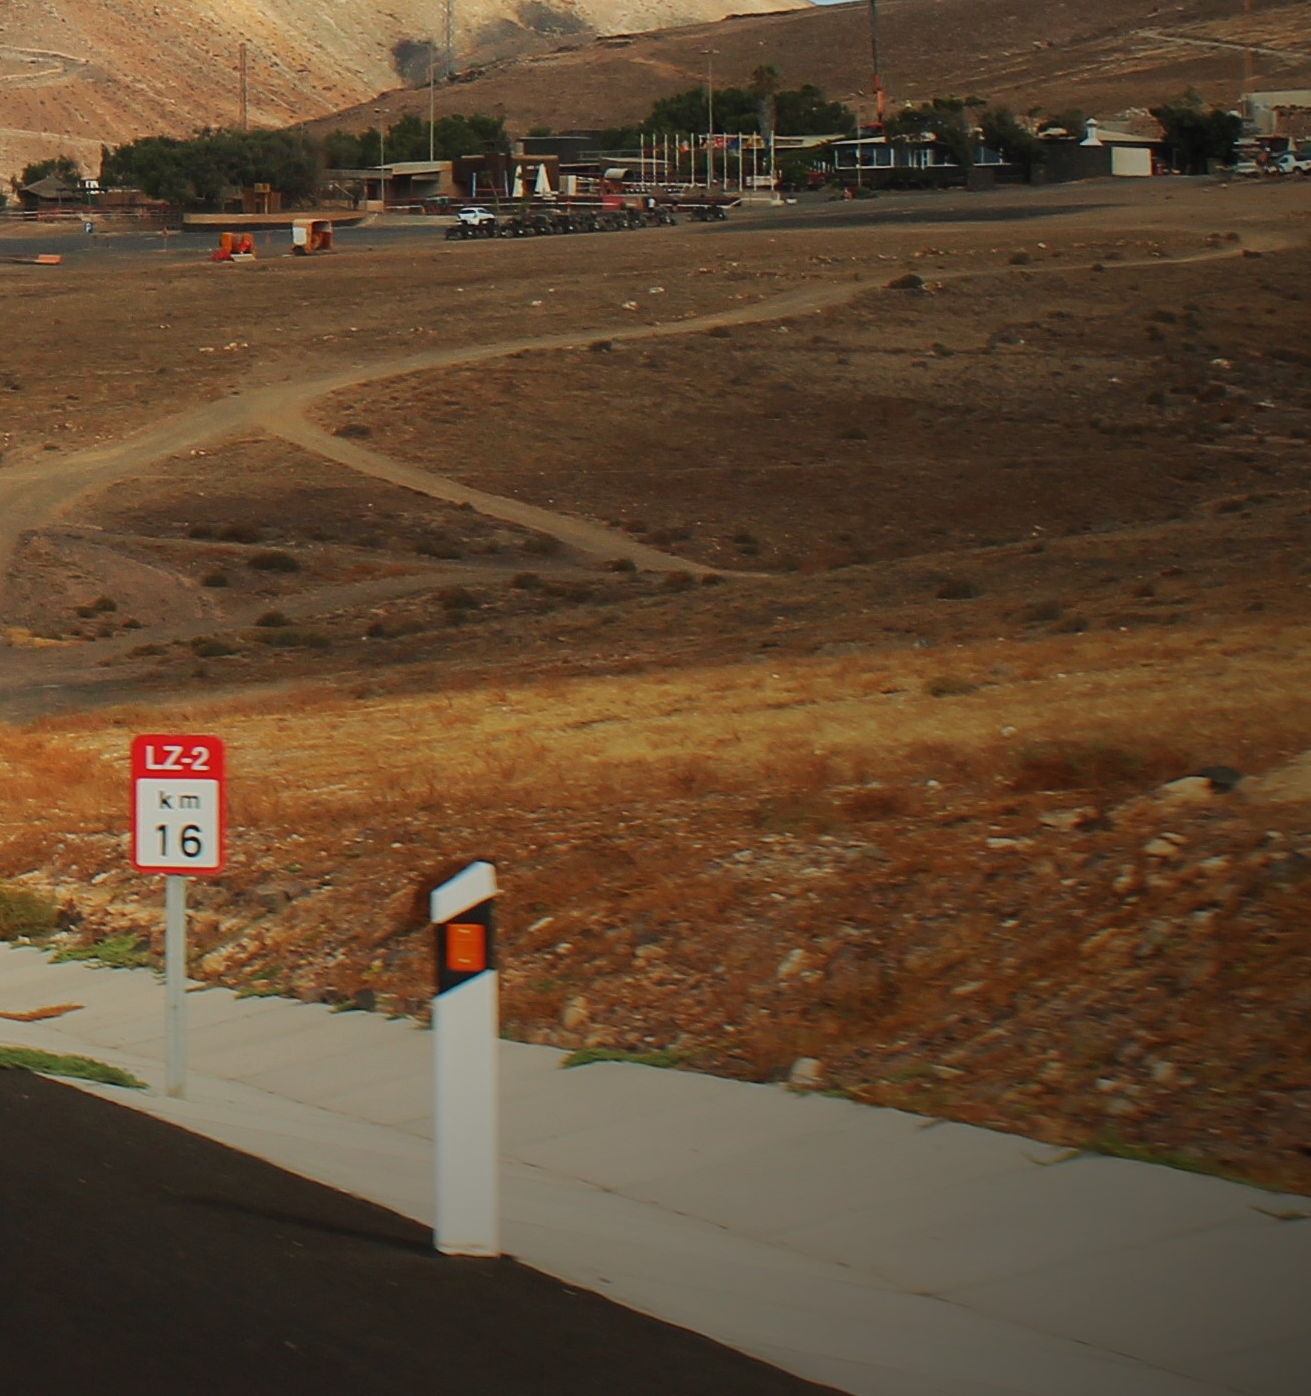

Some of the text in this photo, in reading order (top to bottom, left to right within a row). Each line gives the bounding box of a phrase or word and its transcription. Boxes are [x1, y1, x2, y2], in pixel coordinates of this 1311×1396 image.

[145, 745, 210, 770] LZ-2
[158, 790, 200, 809] km
[156, 824, 203, 858] 16
